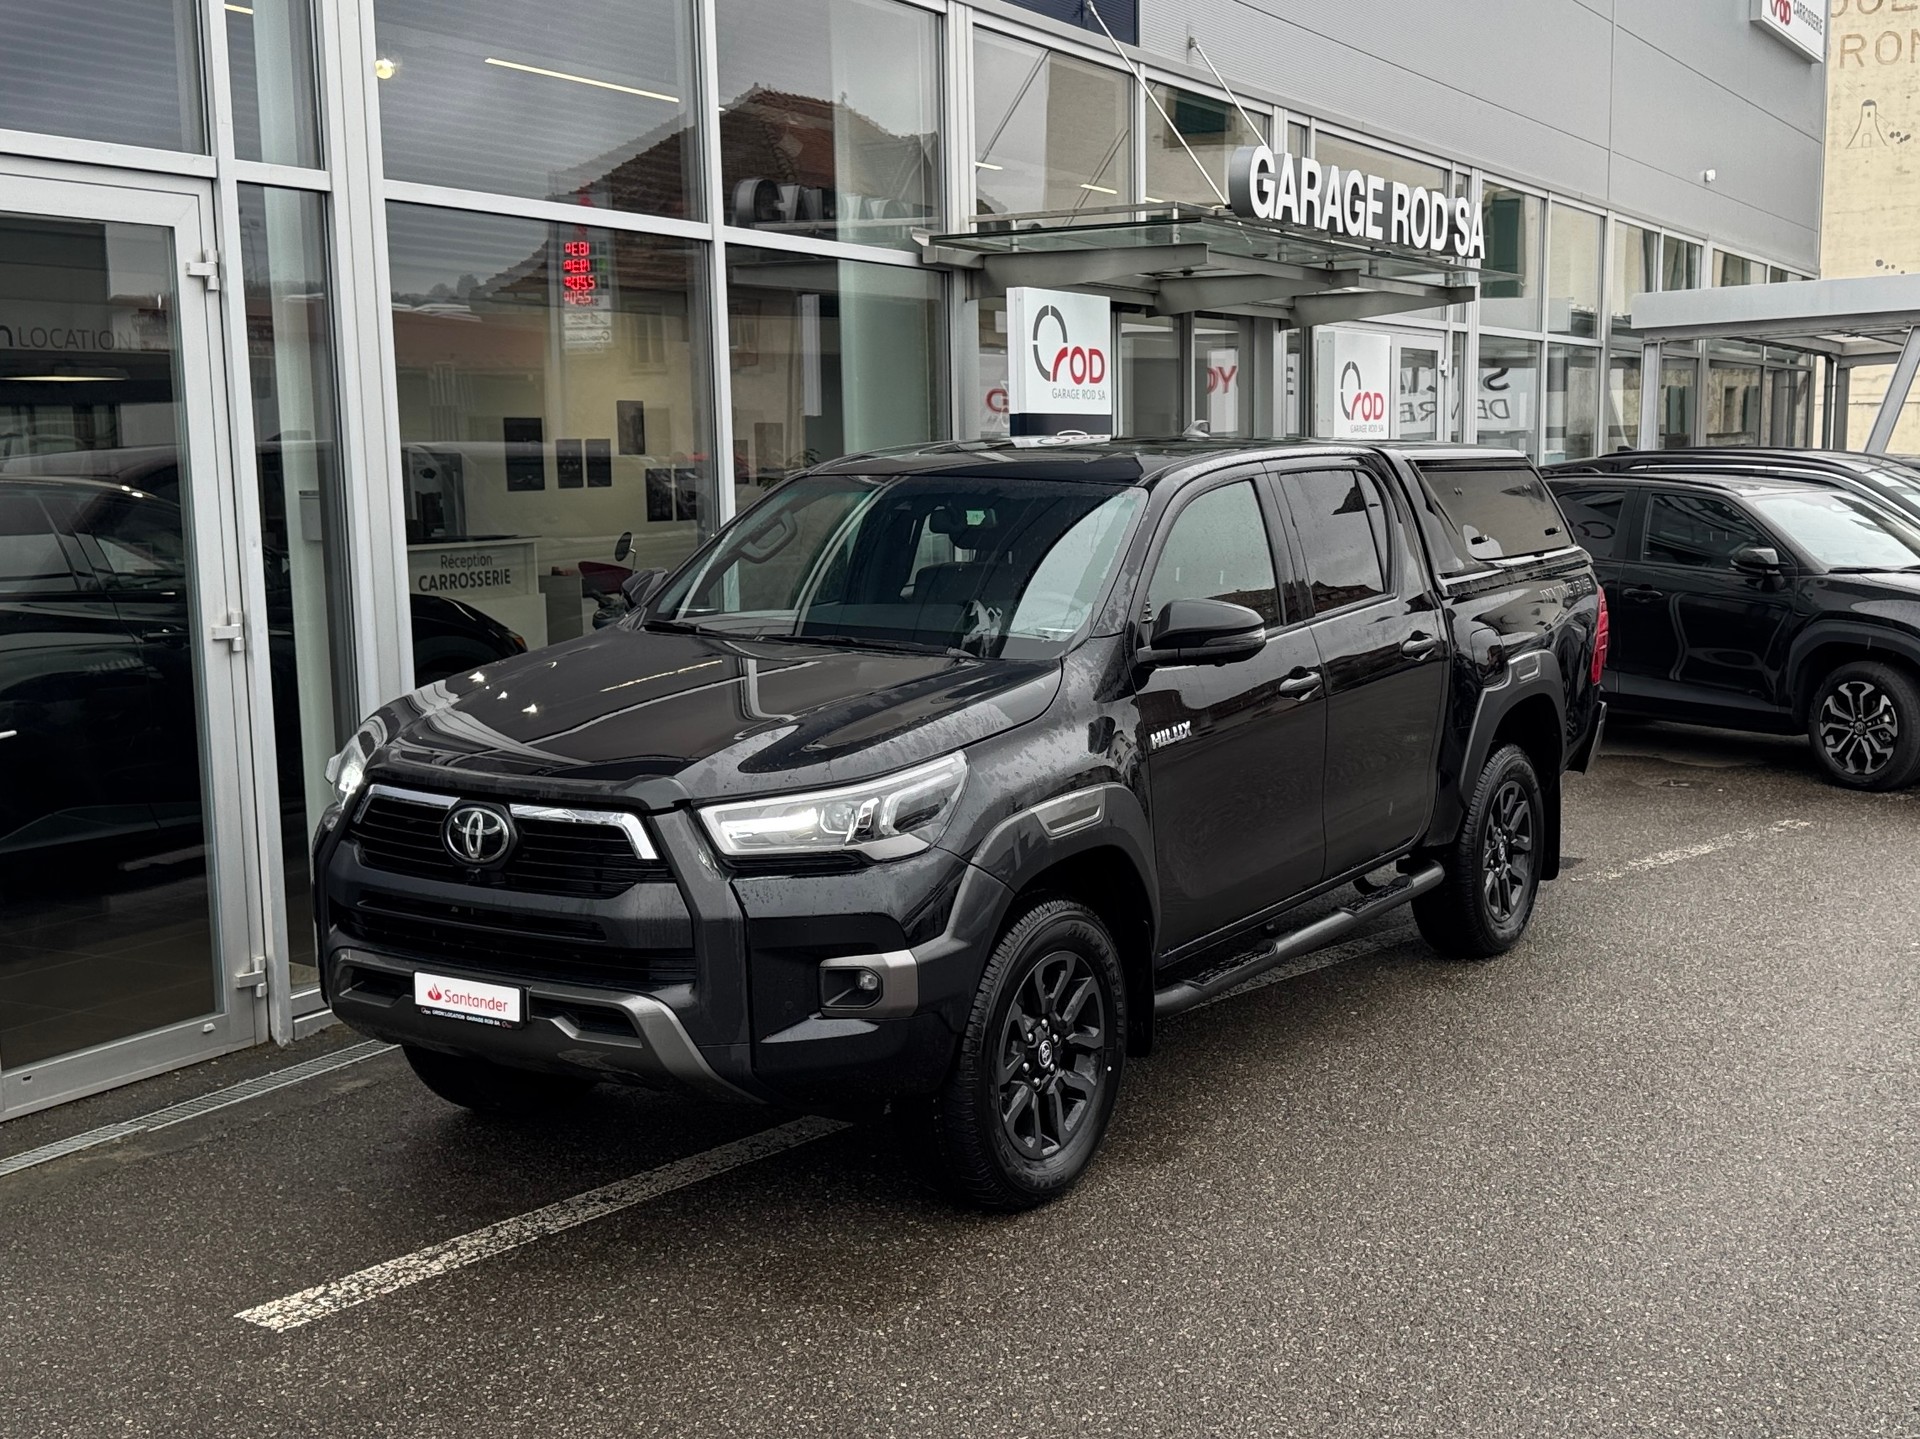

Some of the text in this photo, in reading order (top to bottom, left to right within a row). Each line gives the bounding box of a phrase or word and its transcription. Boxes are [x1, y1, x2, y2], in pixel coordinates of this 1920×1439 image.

[1248, 145, 1486, 259] GARAGE ROD SA
[18, 326, 133, 351] LOCATION
[1051, 388, 1106, 400] GARAGE ROD SA
[1350, 424, 1367, 433] GARAGE
[440, 552, 493, 571] Réception
[418, 569, 512, 592] CARROSSERIE
[1150, 720, 1192, 750] HILUX
[444, 989, 508, 1013] Santander
[466, 1015, 484, 1023] GARAGE
